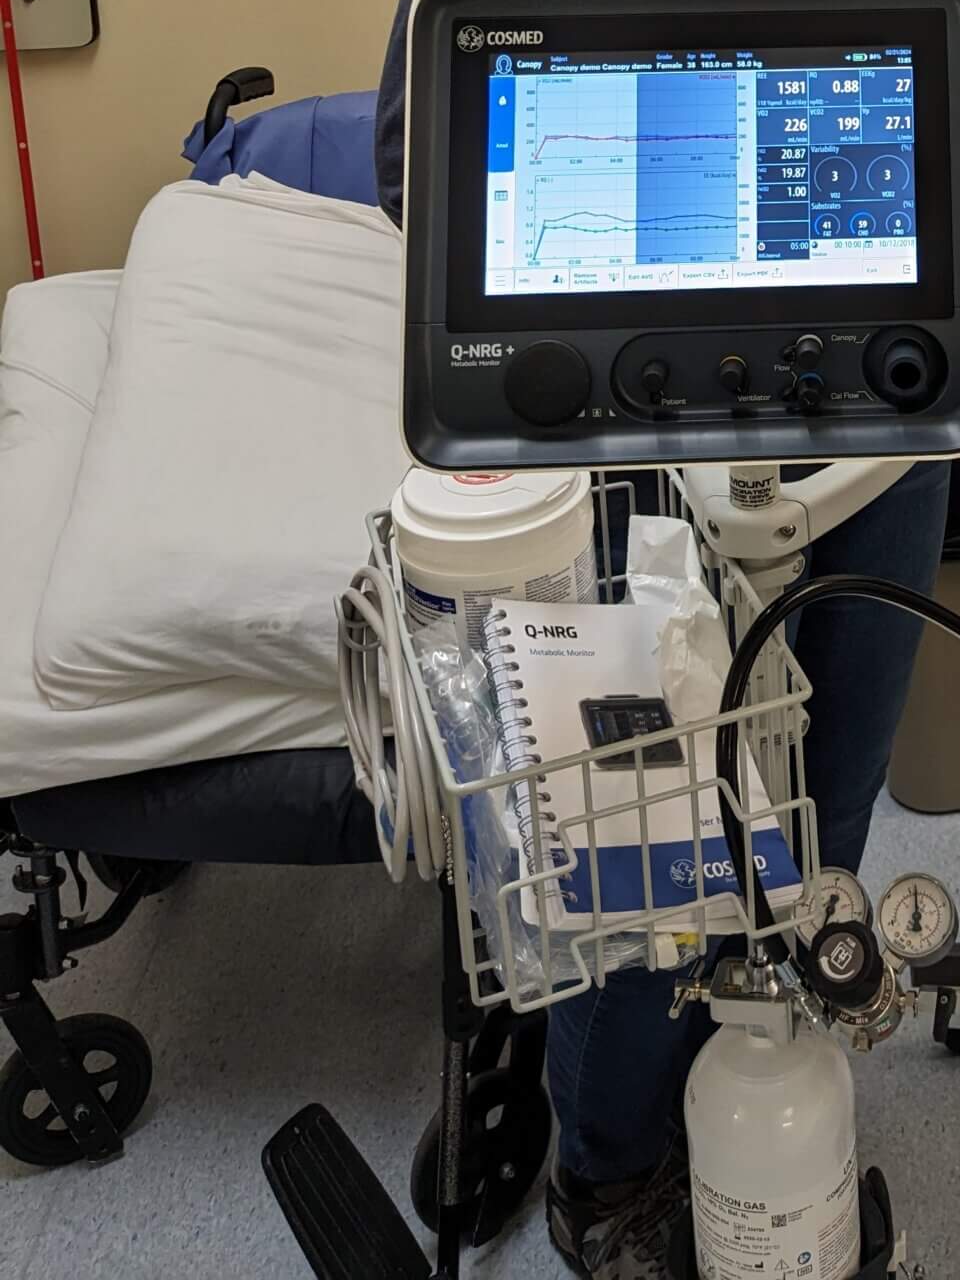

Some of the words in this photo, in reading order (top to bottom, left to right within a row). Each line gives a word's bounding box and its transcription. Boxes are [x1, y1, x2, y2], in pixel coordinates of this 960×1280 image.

[487, 31, 544, 45] COSMED
[517, 60, 542, 69] Canopy
[550, 64, 578, 73] Canopy
[602, 63, 630, 72] Canopy
[753, 60, 763, 69] kg
[777, 81, 806, 94] 1581
[832, 80, 859, 93] 0.88
[895, 79, 911, 92] 27
[784, 119, 807, 131] 226
[837, 118, 859, 130] 199
[885, 116, 911, 129] 27.1
[811, 145, 839, 154] Variability
[901, 144, 912, 153] (%)
[781, 149, 806, 160] 20.87
[781, 168, 806, 179] 19.87
[831, 171, 838, 182] 3
[884, 169, 891, 181] 3
[787, 186, 806, 197] 1.00
[811, 202, 841, 210] Substrates
[903, 200, 914, 209] (%)
[822, 221, 831, 229] 41
[858, 220, 867, 228] 59
[895, 219, 901, 227] 0
[790, 242, 809, 250] 05:00
[834, 240, 862, 248] 00:10:00
[831, 334, 857, 343] Canopy
[450, 344, 502, 360] Q-NRG
[479, 359, 500, 367] Monitor
[737, 394, 771, 402] Ventilator
[831, 392, 842, 400] Cal
[843, 392, 860, 400] Flow
[661, 398, 686, 406] Patient
[524, 624, 578, 639] Q-NRG
[529, 648, 565, 657] Metabolic
[566, 648, 595, 657] Monitor
[699, 817, 714, 827] ser
[703, 854, 767, 879] COSD
[743, 1202, 766, 1211] GAS
